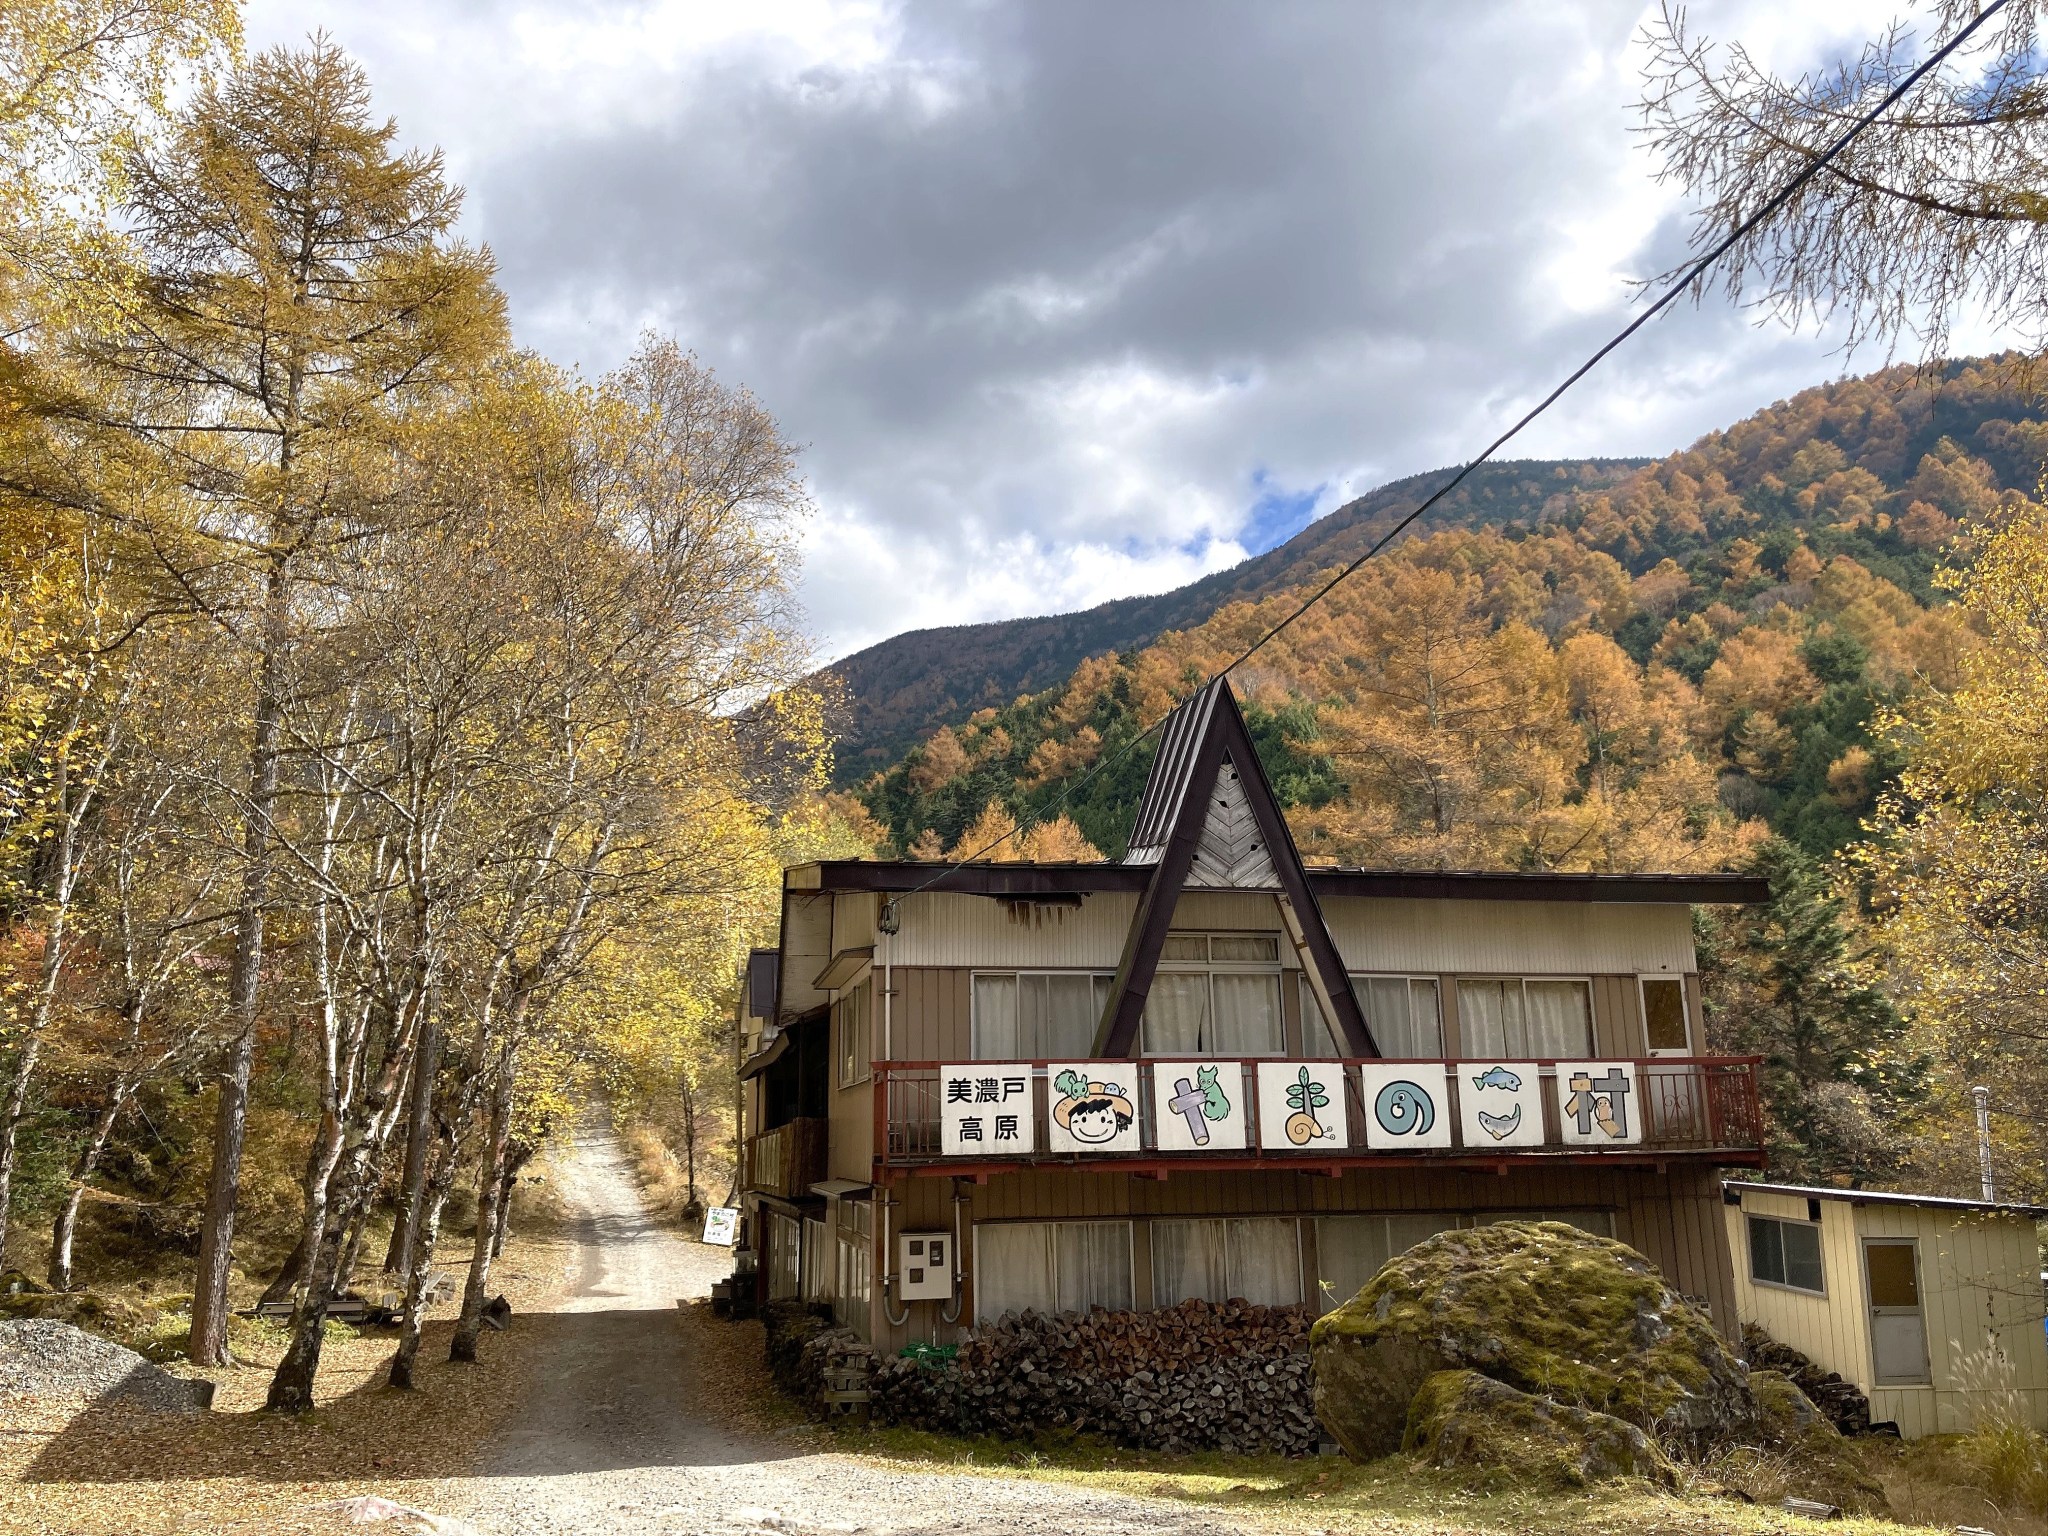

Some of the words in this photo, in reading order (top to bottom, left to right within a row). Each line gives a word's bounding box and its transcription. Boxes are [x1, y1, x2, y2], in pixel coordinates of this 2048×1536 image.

[947, 1076, 1026, 1104] 美濃戸
[958, 1115, 1019, 1142] 高原
